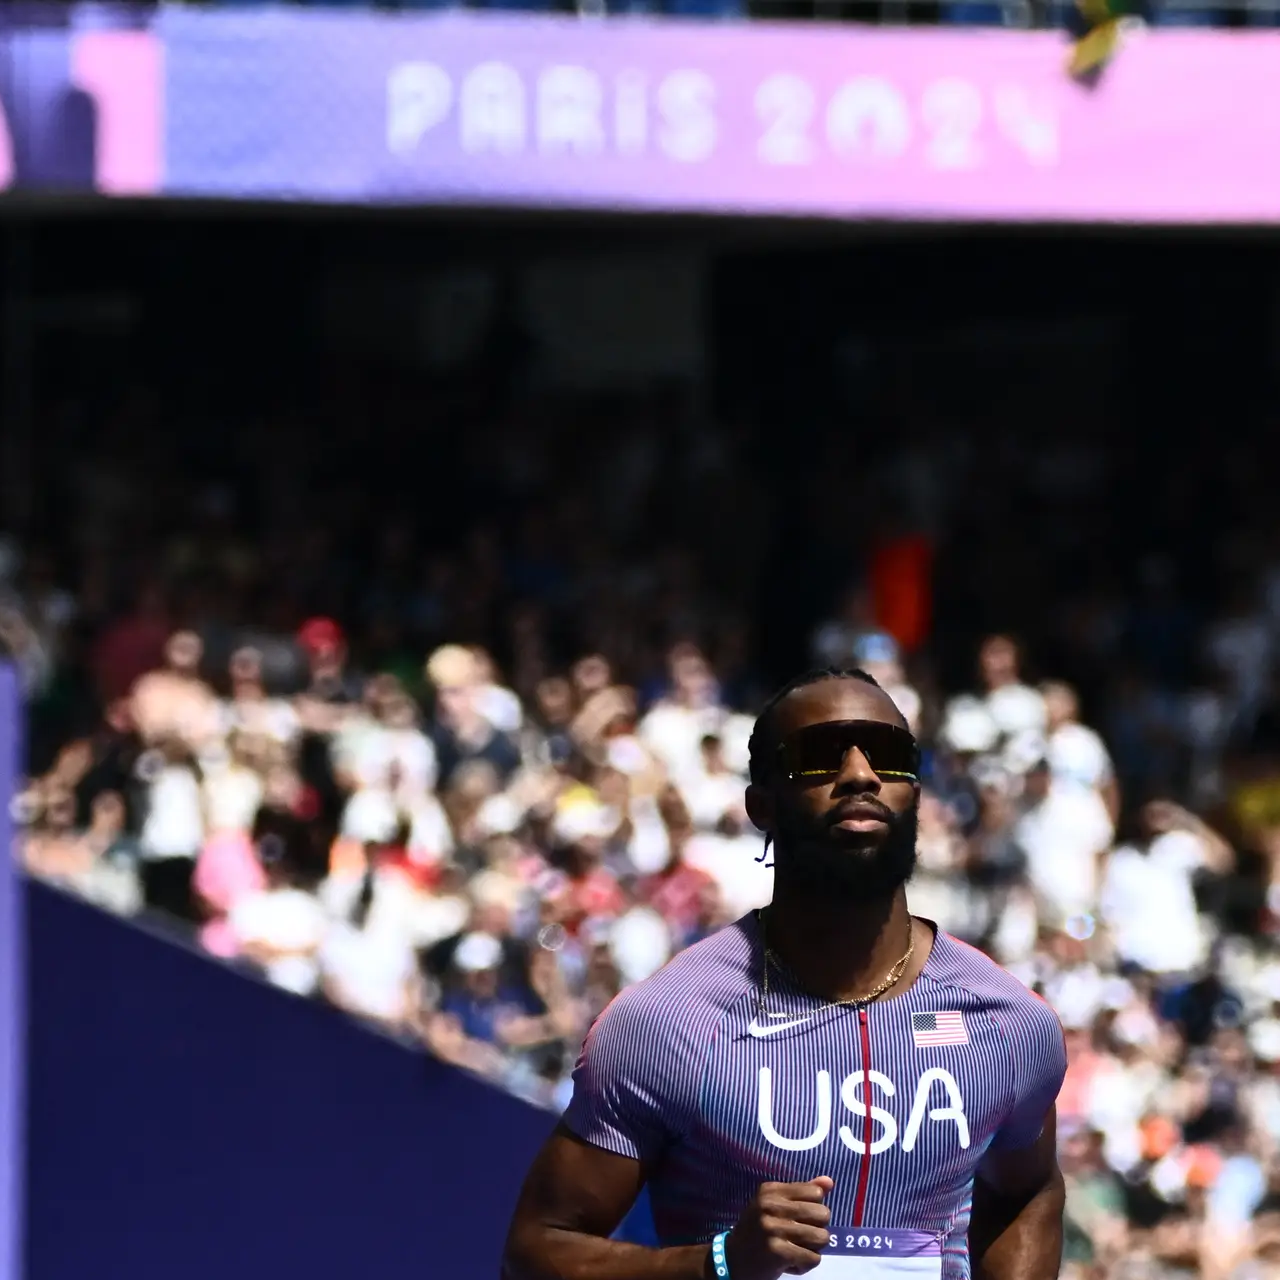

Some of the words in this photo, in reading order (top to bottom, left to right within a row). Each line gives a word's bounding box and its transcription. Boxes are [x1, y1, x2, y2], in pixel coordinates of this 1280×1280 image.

[753, 72, 1061, 172] 2024
[758, 1066, 970, 1155] USA
[845, 1235, 893, 1249] 2024
